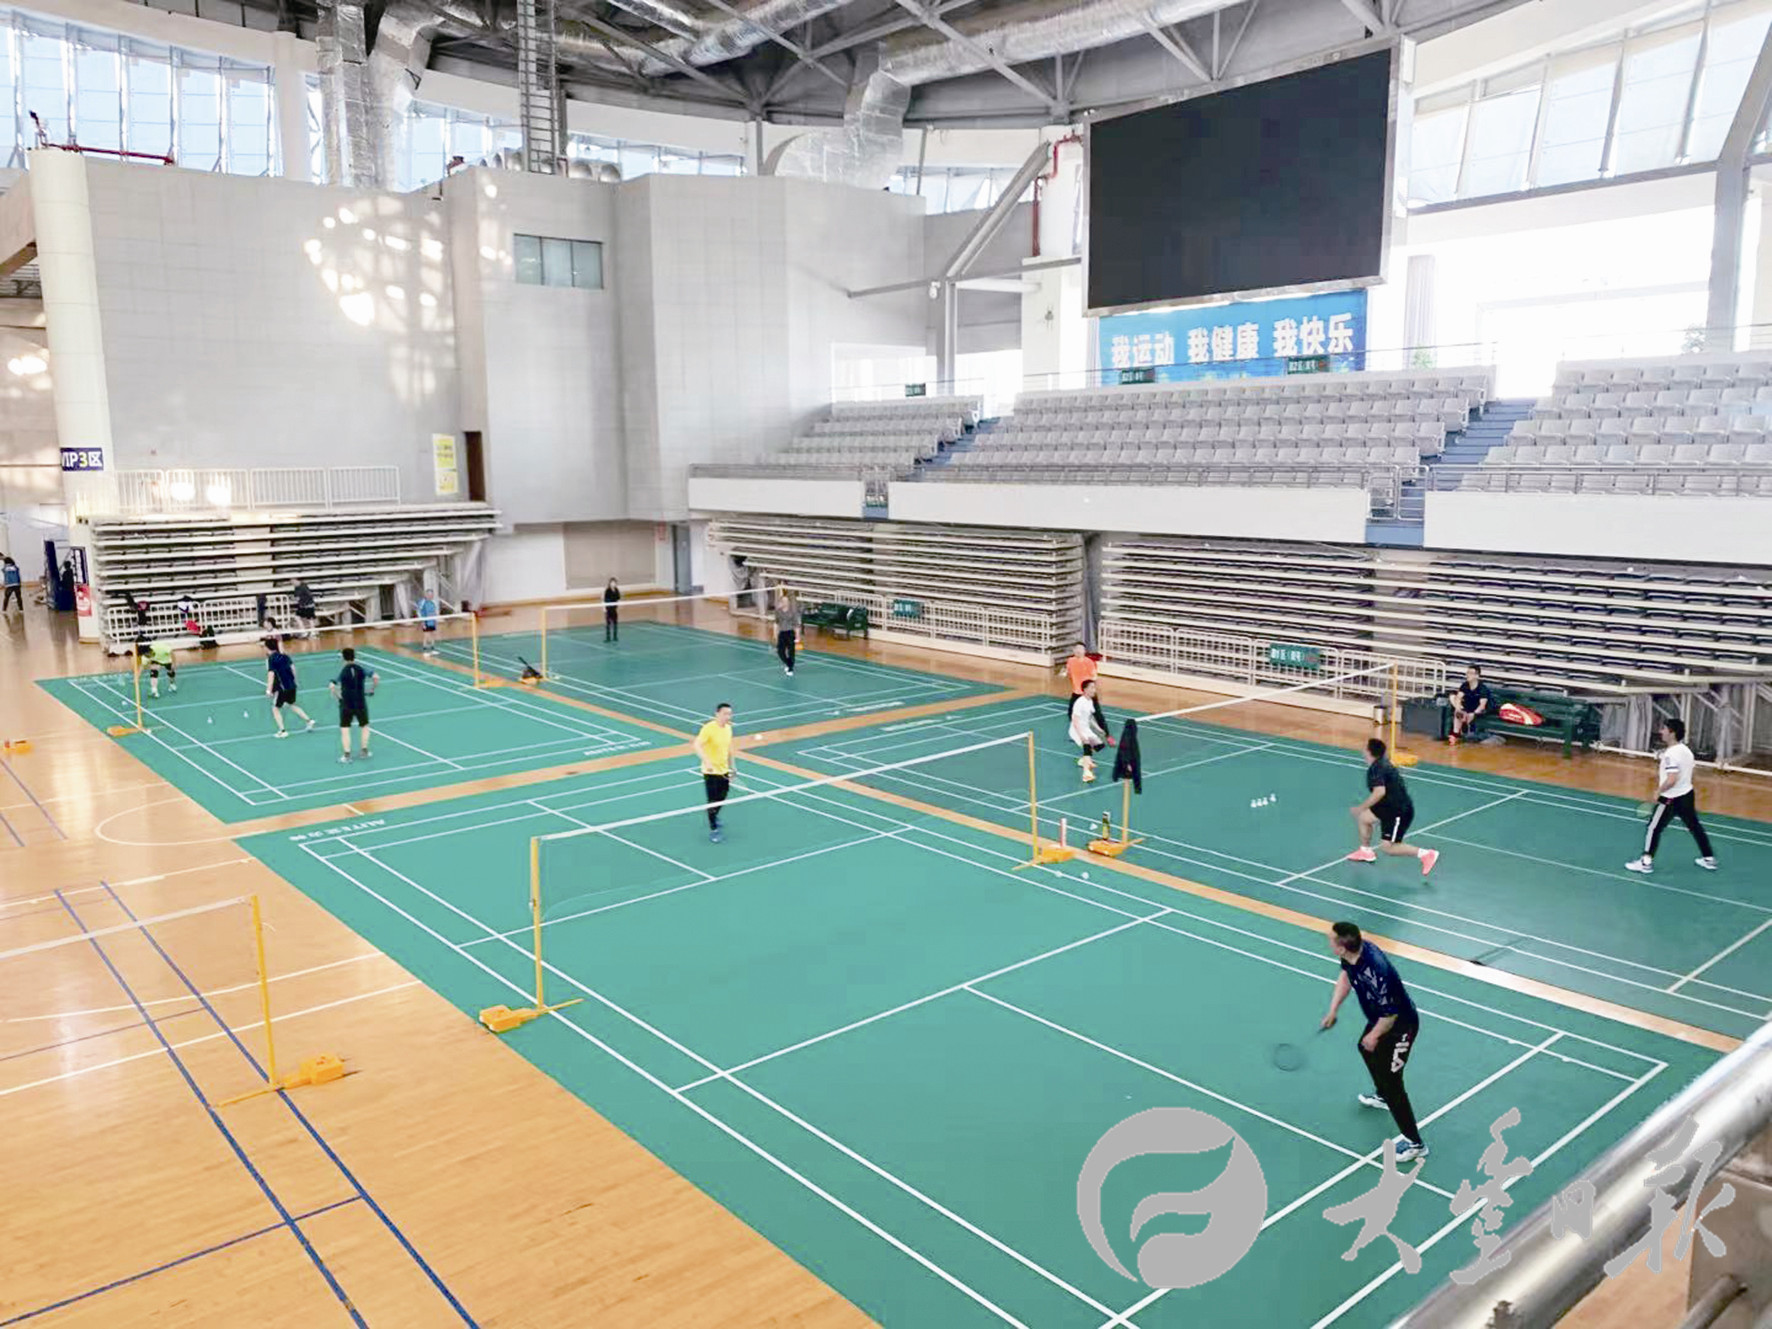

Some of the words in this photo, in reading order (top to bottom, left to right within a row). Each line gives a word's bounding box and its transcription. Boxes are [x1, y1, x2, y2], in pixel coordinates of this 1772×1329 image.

[1111, 331, 1175, 367] 我运动
[1187, 321, 1260, 363] 我健康
[1272, 312, 1354, 358] 我快乐
